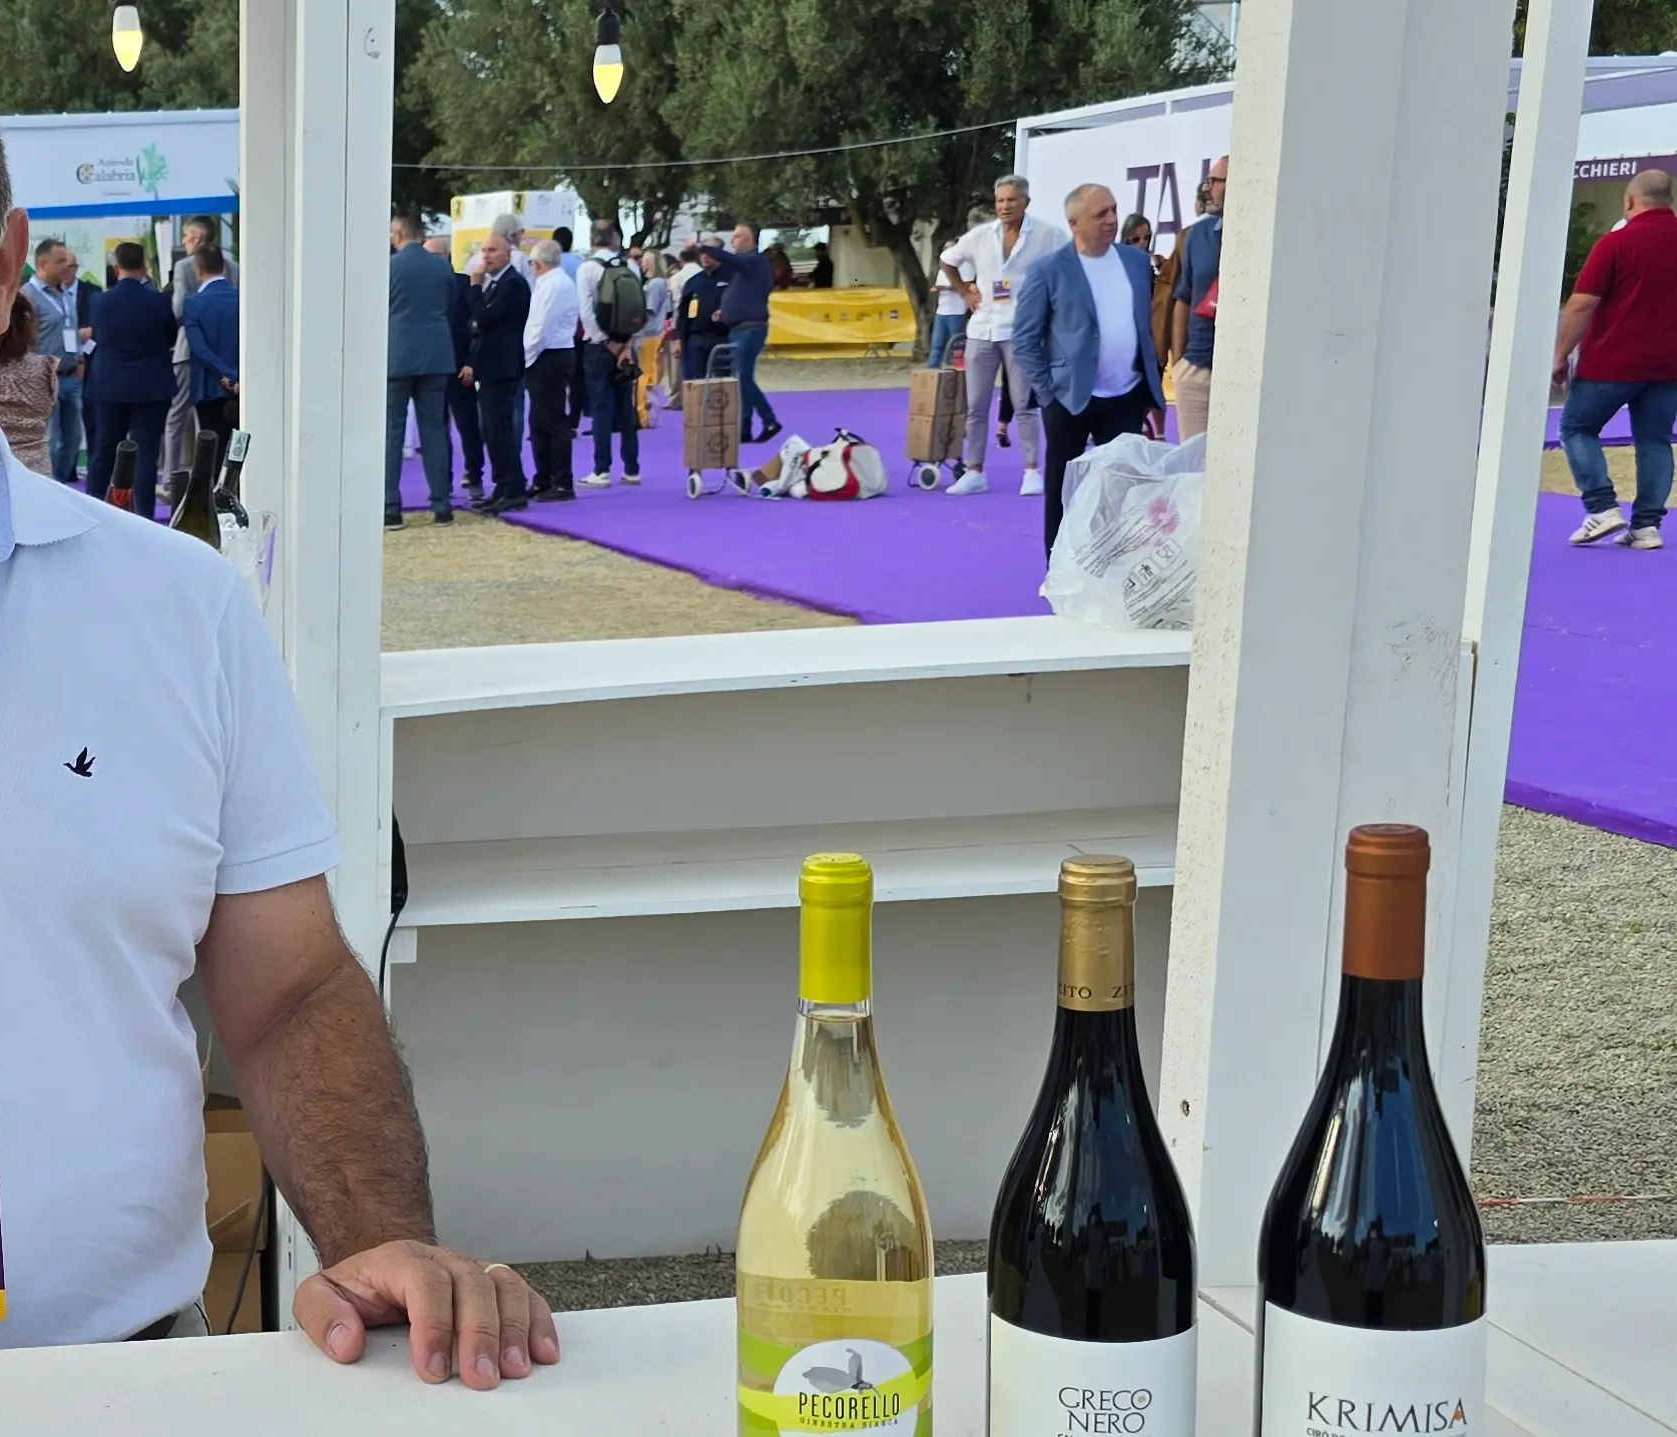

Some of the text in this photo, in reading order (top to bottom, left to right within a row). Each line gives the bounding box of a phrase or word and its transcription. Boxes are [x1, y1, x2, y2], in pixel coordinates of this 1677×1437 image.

[798, 1392, 900, 1420] PECORELLO
[1058, 1386, 1152, 1411] GRECO
[799, 1417, 899, 1429] GINESTRA BIANCA
[1066, 1410, 1145, 1434] NERO
[1306, 1391, 1468, 1434] KRIMISA
